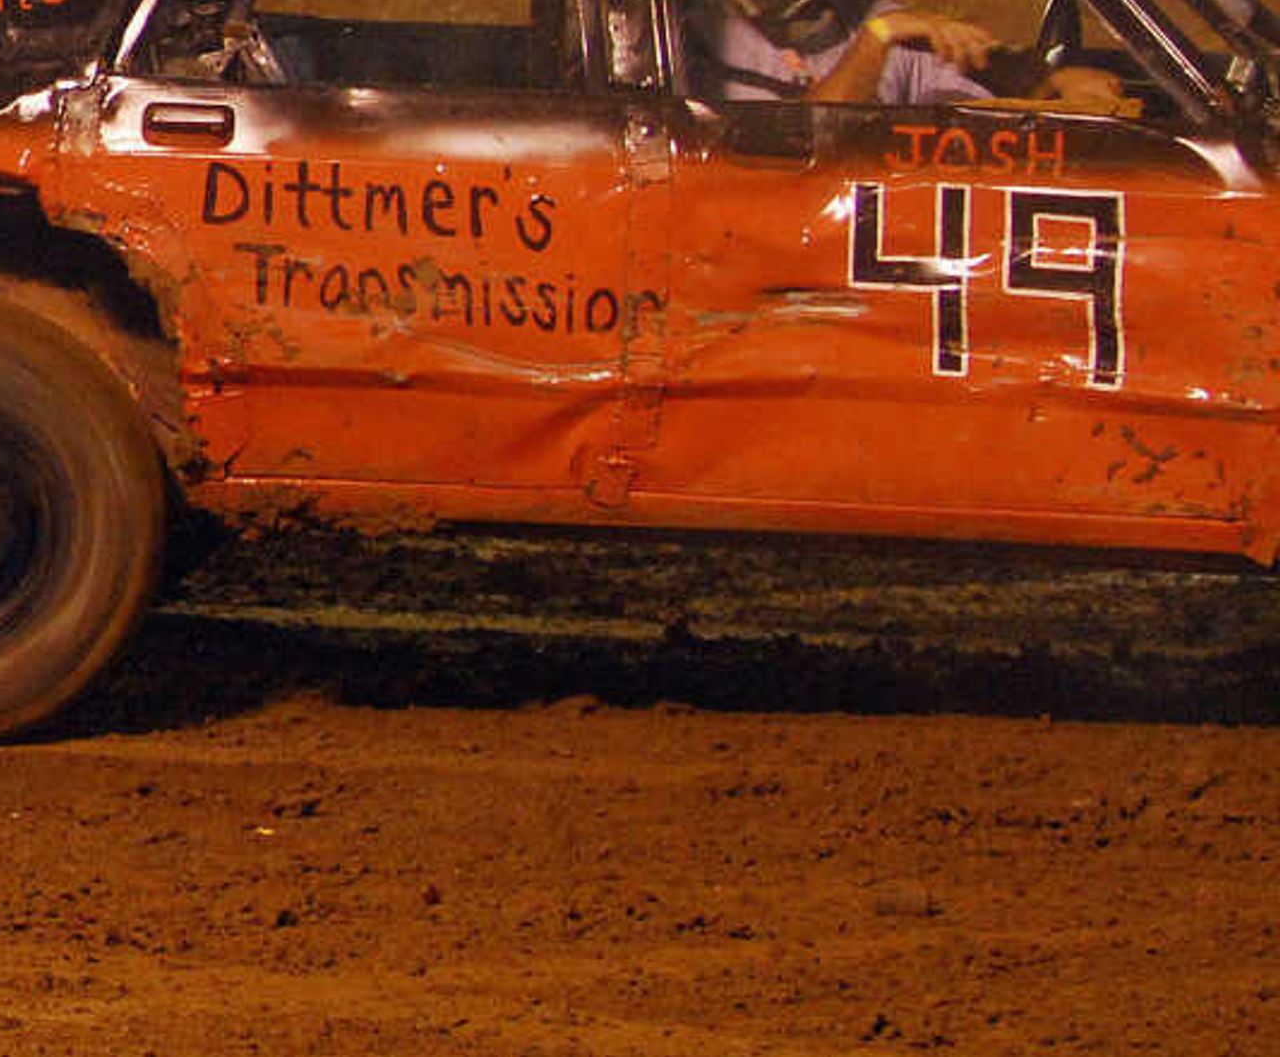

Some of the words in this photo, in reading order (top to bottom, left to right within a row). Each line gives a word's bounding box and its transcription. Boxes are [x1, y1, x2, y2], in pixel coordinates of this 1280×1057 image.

[884, 123, 1067, 178] JOSH
[201, 161, 557, 253] Dittmer's
[847, 180, 1126, 391] 49
